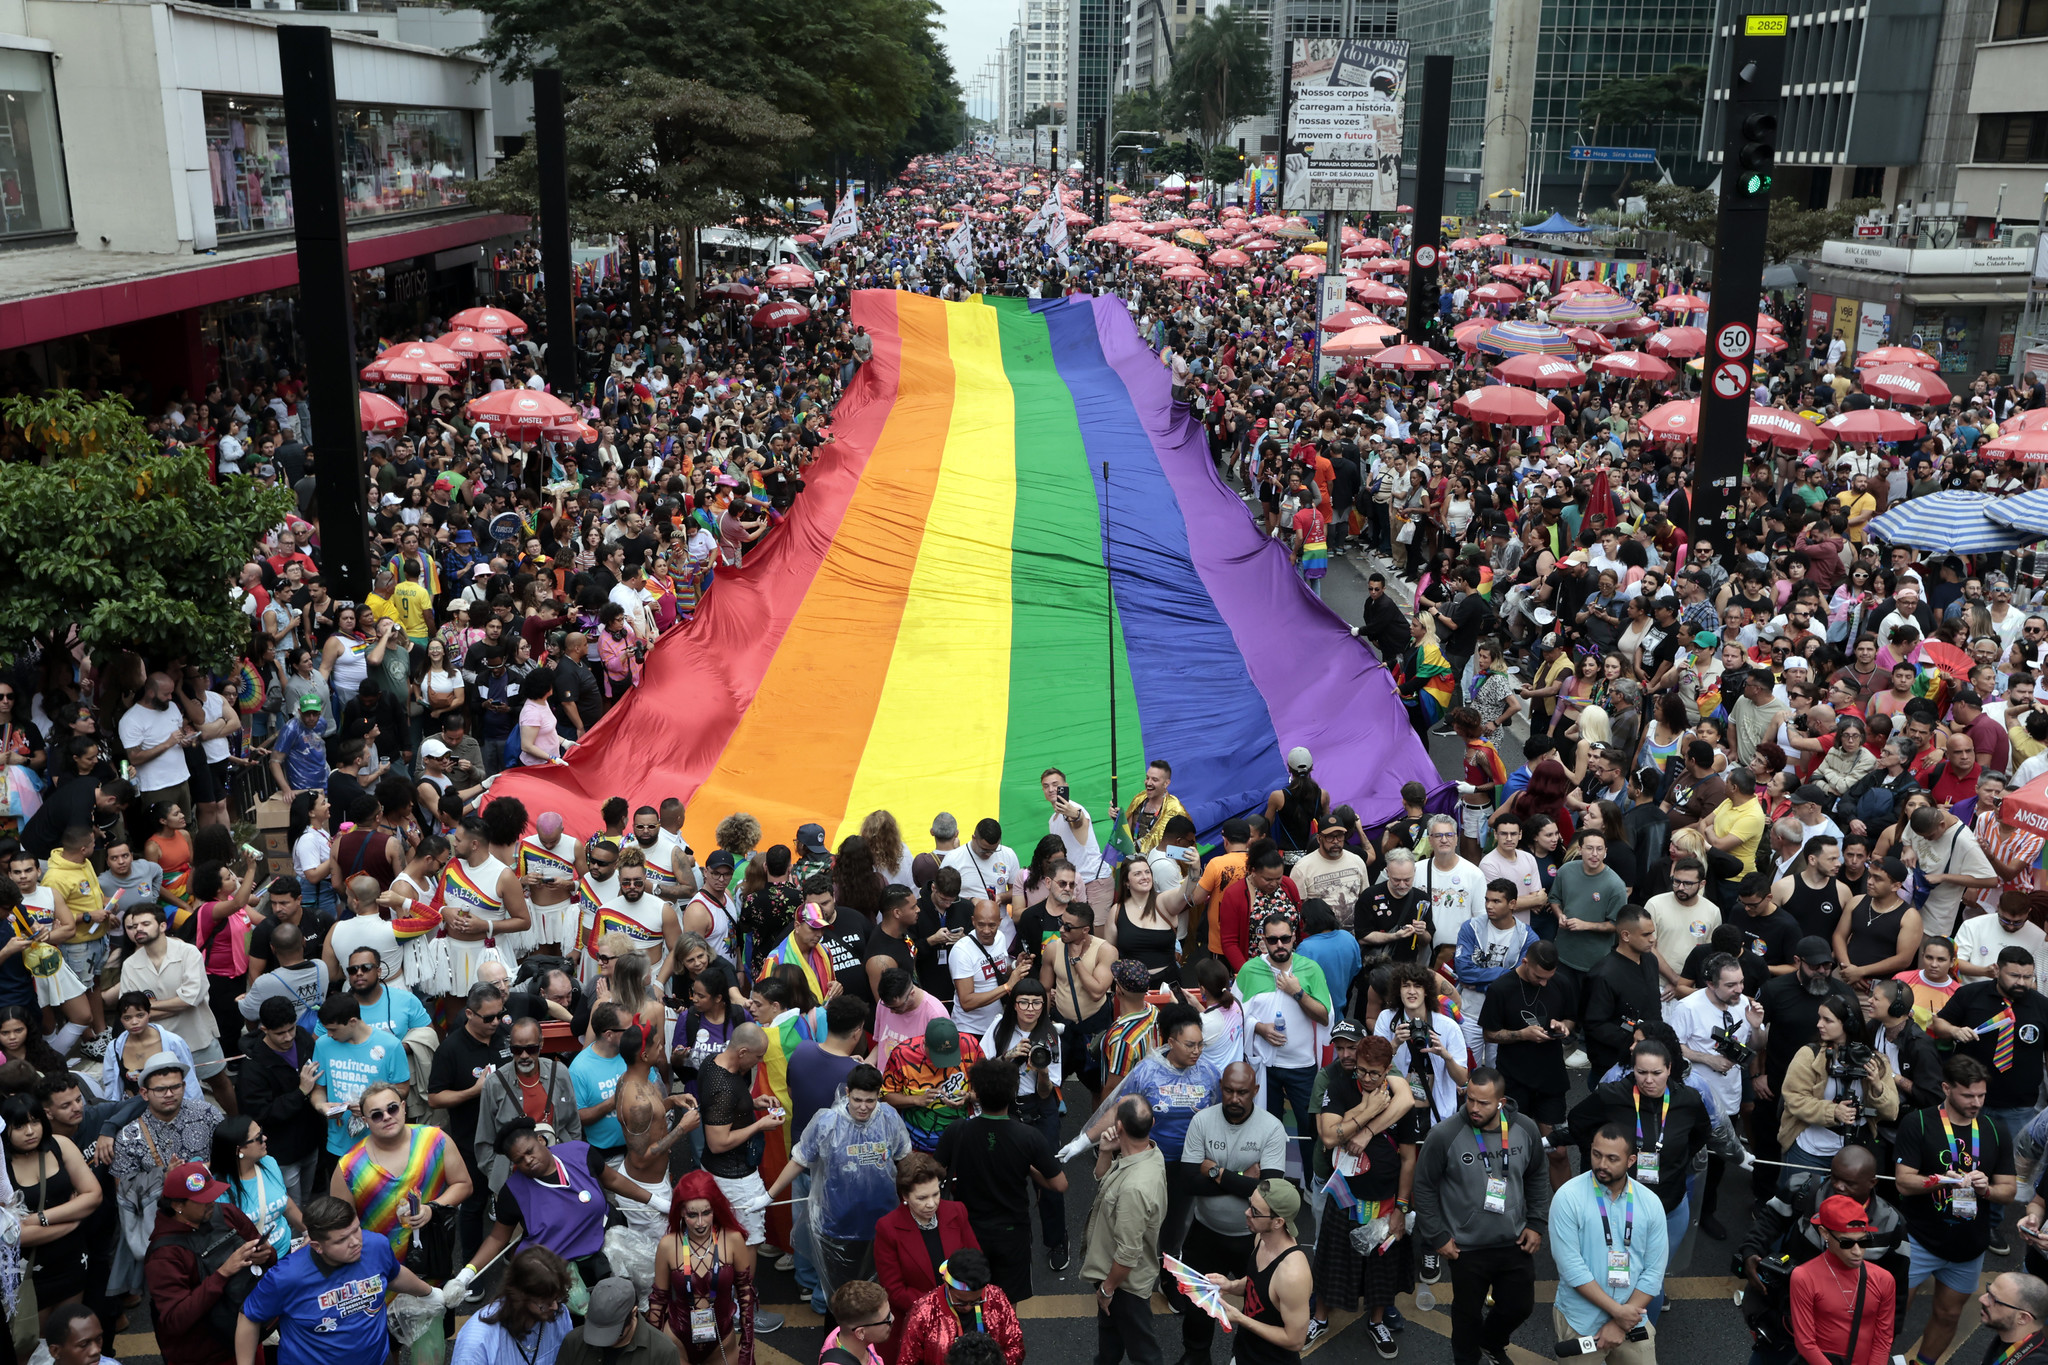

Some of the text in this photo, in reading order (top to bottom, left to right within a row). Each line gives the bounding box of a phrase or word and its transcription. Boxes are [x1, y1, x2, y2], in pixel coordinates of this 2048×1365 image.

[1757, 20, 1783, 31] 2825
[1343, 44, 1395, 68] do povo
[1300, 89, 1369, 99] Nossos corpos
[1299, 104, 1345, 114] carregam
[1355, 103, 1394, 113] história,
[1298, 117, 1331, 125] nossas
[1343, 131, 1373, 140] futuro
[1339, 170, 1353, 178] SÃO
[394, 267, 428, 303] marisa
[770, 307, 800, 320] BRAHMA
[1812, 309, 1828, 320] SUPER
[1723, 330, 1748, 348] 50
[1602, 353, 1637, 368] BRAHMA
[1538, 362, 1578, 376] BRAHMA
[1875, 373, 1922, 393] BRAHMA
[480, 413, 501, 421] AMSTEL
[518, 416, 543, 424] AMSTEL
[1749, 414, 1802, 435] BRAHMA
[1985, 449, 2006, 458] AMSTEL
[2023, 452, 2048, 460] AMSTE
[401, 597, 409, 619] 9
[2013, 808, 2048, 832] AMSTE
[449, 886, 483, 906] HEERS
[329, 1058, 379, 1075] POLÍTICA&
[330, 1069, 370, 1084] GARRA&
[1208, 1140, 1226, 1151] 169
[1477, 1146, 1523, 1160] OAKEY
[319, 1275, 382, 1308] ENVELHECER
